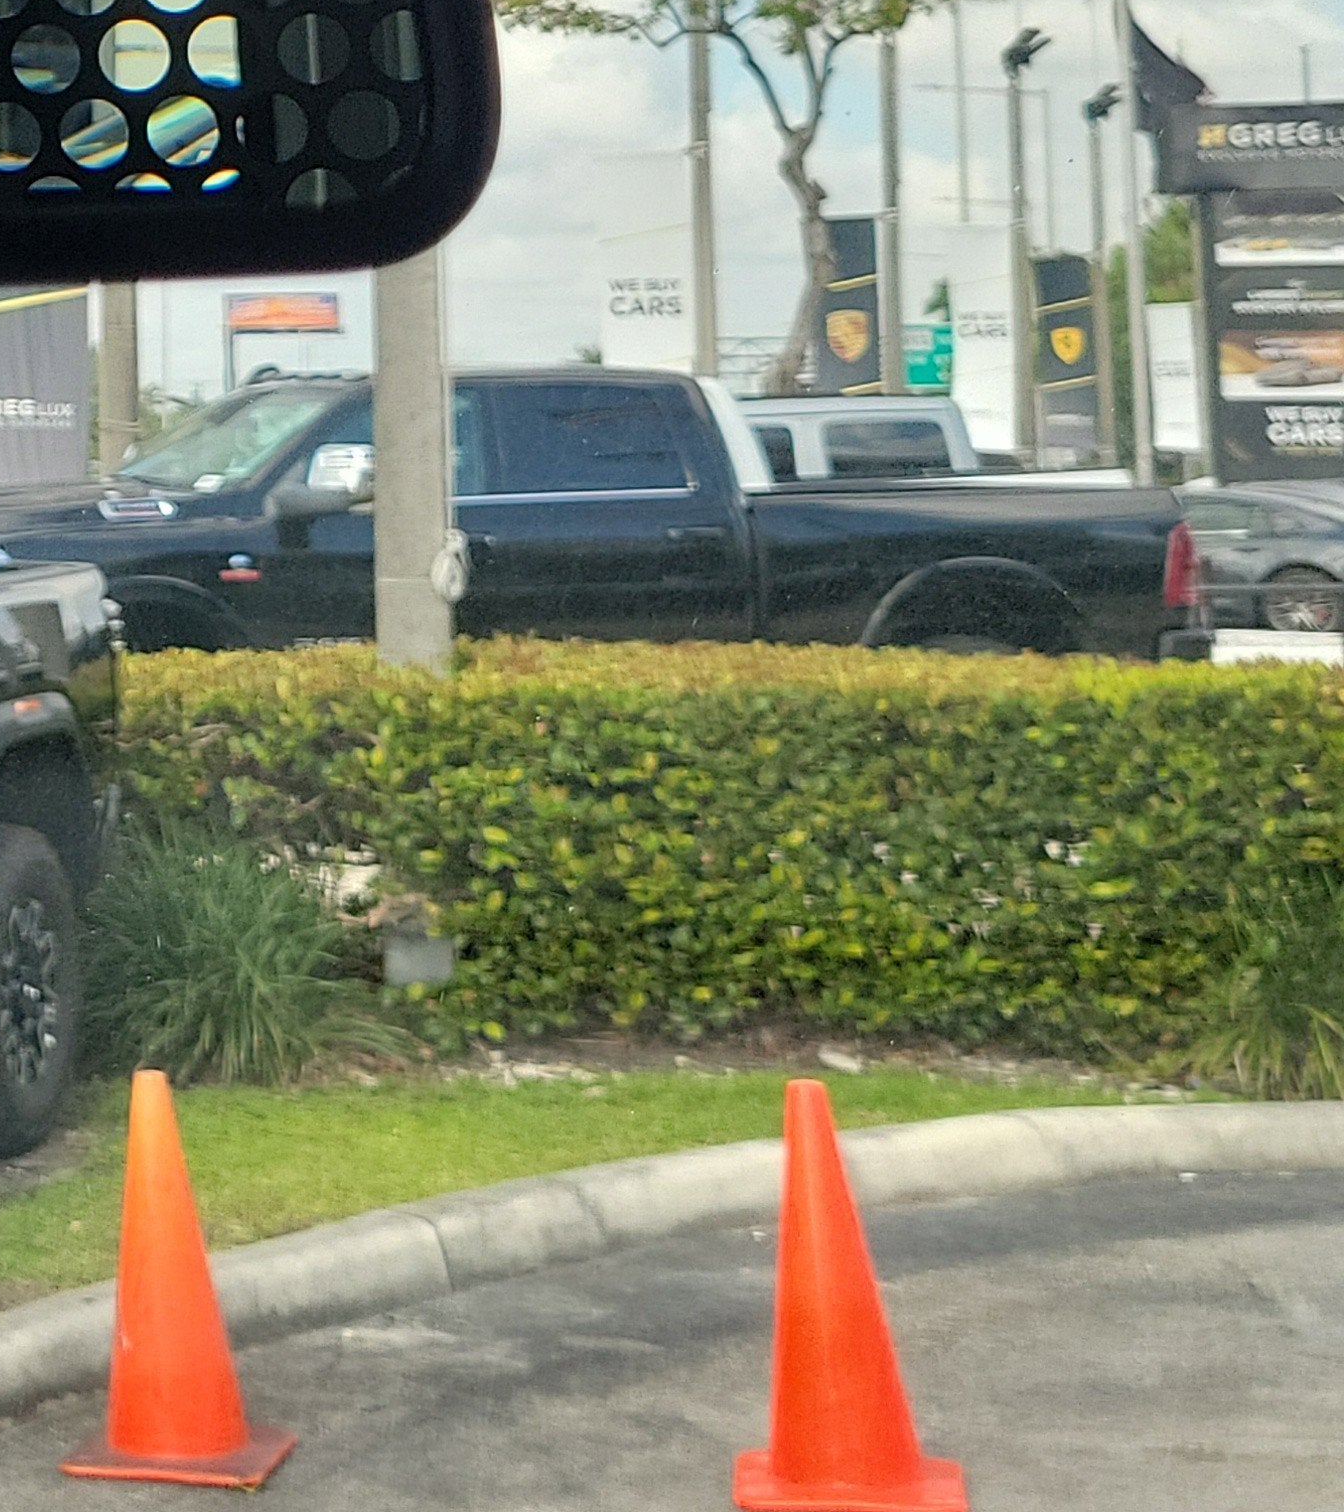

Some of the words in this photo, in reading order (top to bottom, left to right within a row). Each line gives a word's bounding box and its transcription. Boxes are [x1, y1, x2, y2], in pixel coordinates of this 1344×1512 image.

[1227, 121, 1323, 150] GREG
[609, 296, 682, 316] CARS
[1267, 422, 1344, 446] CARS
